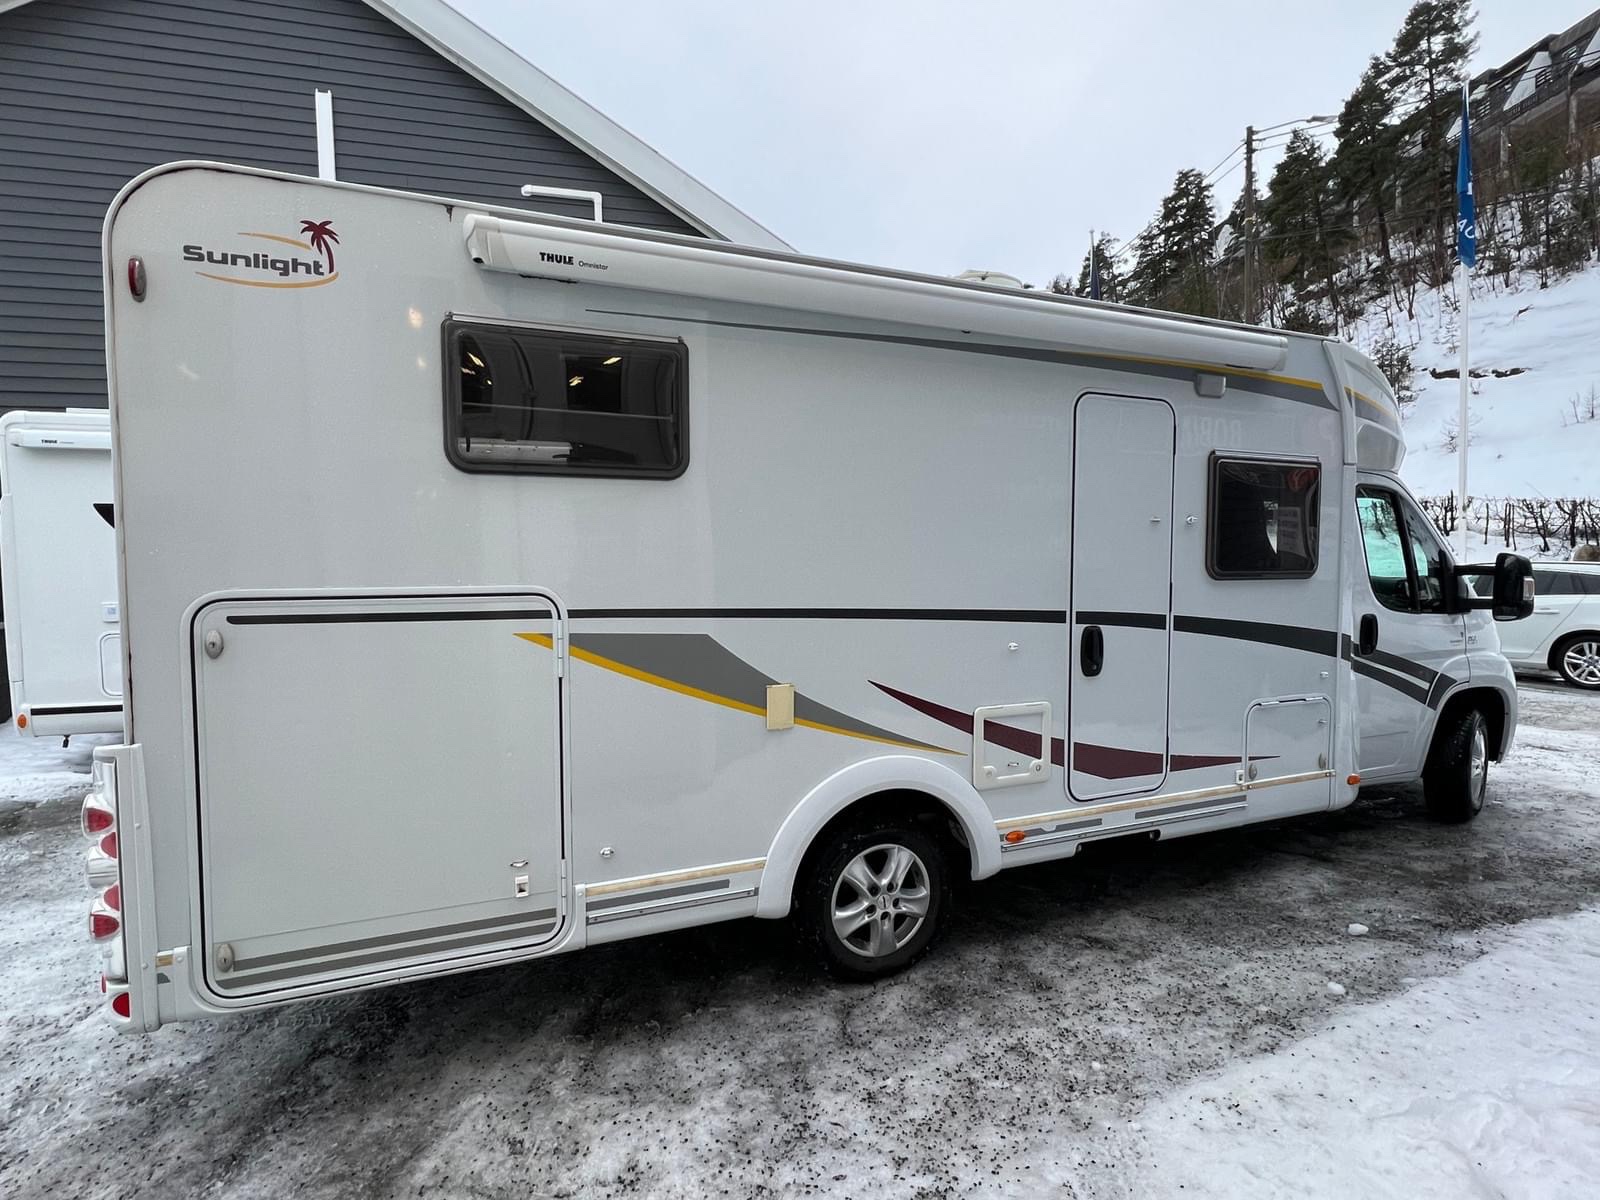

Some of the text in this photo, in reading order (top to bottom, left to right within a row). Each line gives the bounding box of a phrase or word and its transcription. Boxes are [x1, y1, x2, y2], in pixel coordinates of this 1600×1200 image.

[183, 245, 325, 276] Sunlight
[539, 251, 609, 271] THULE Omnistor
